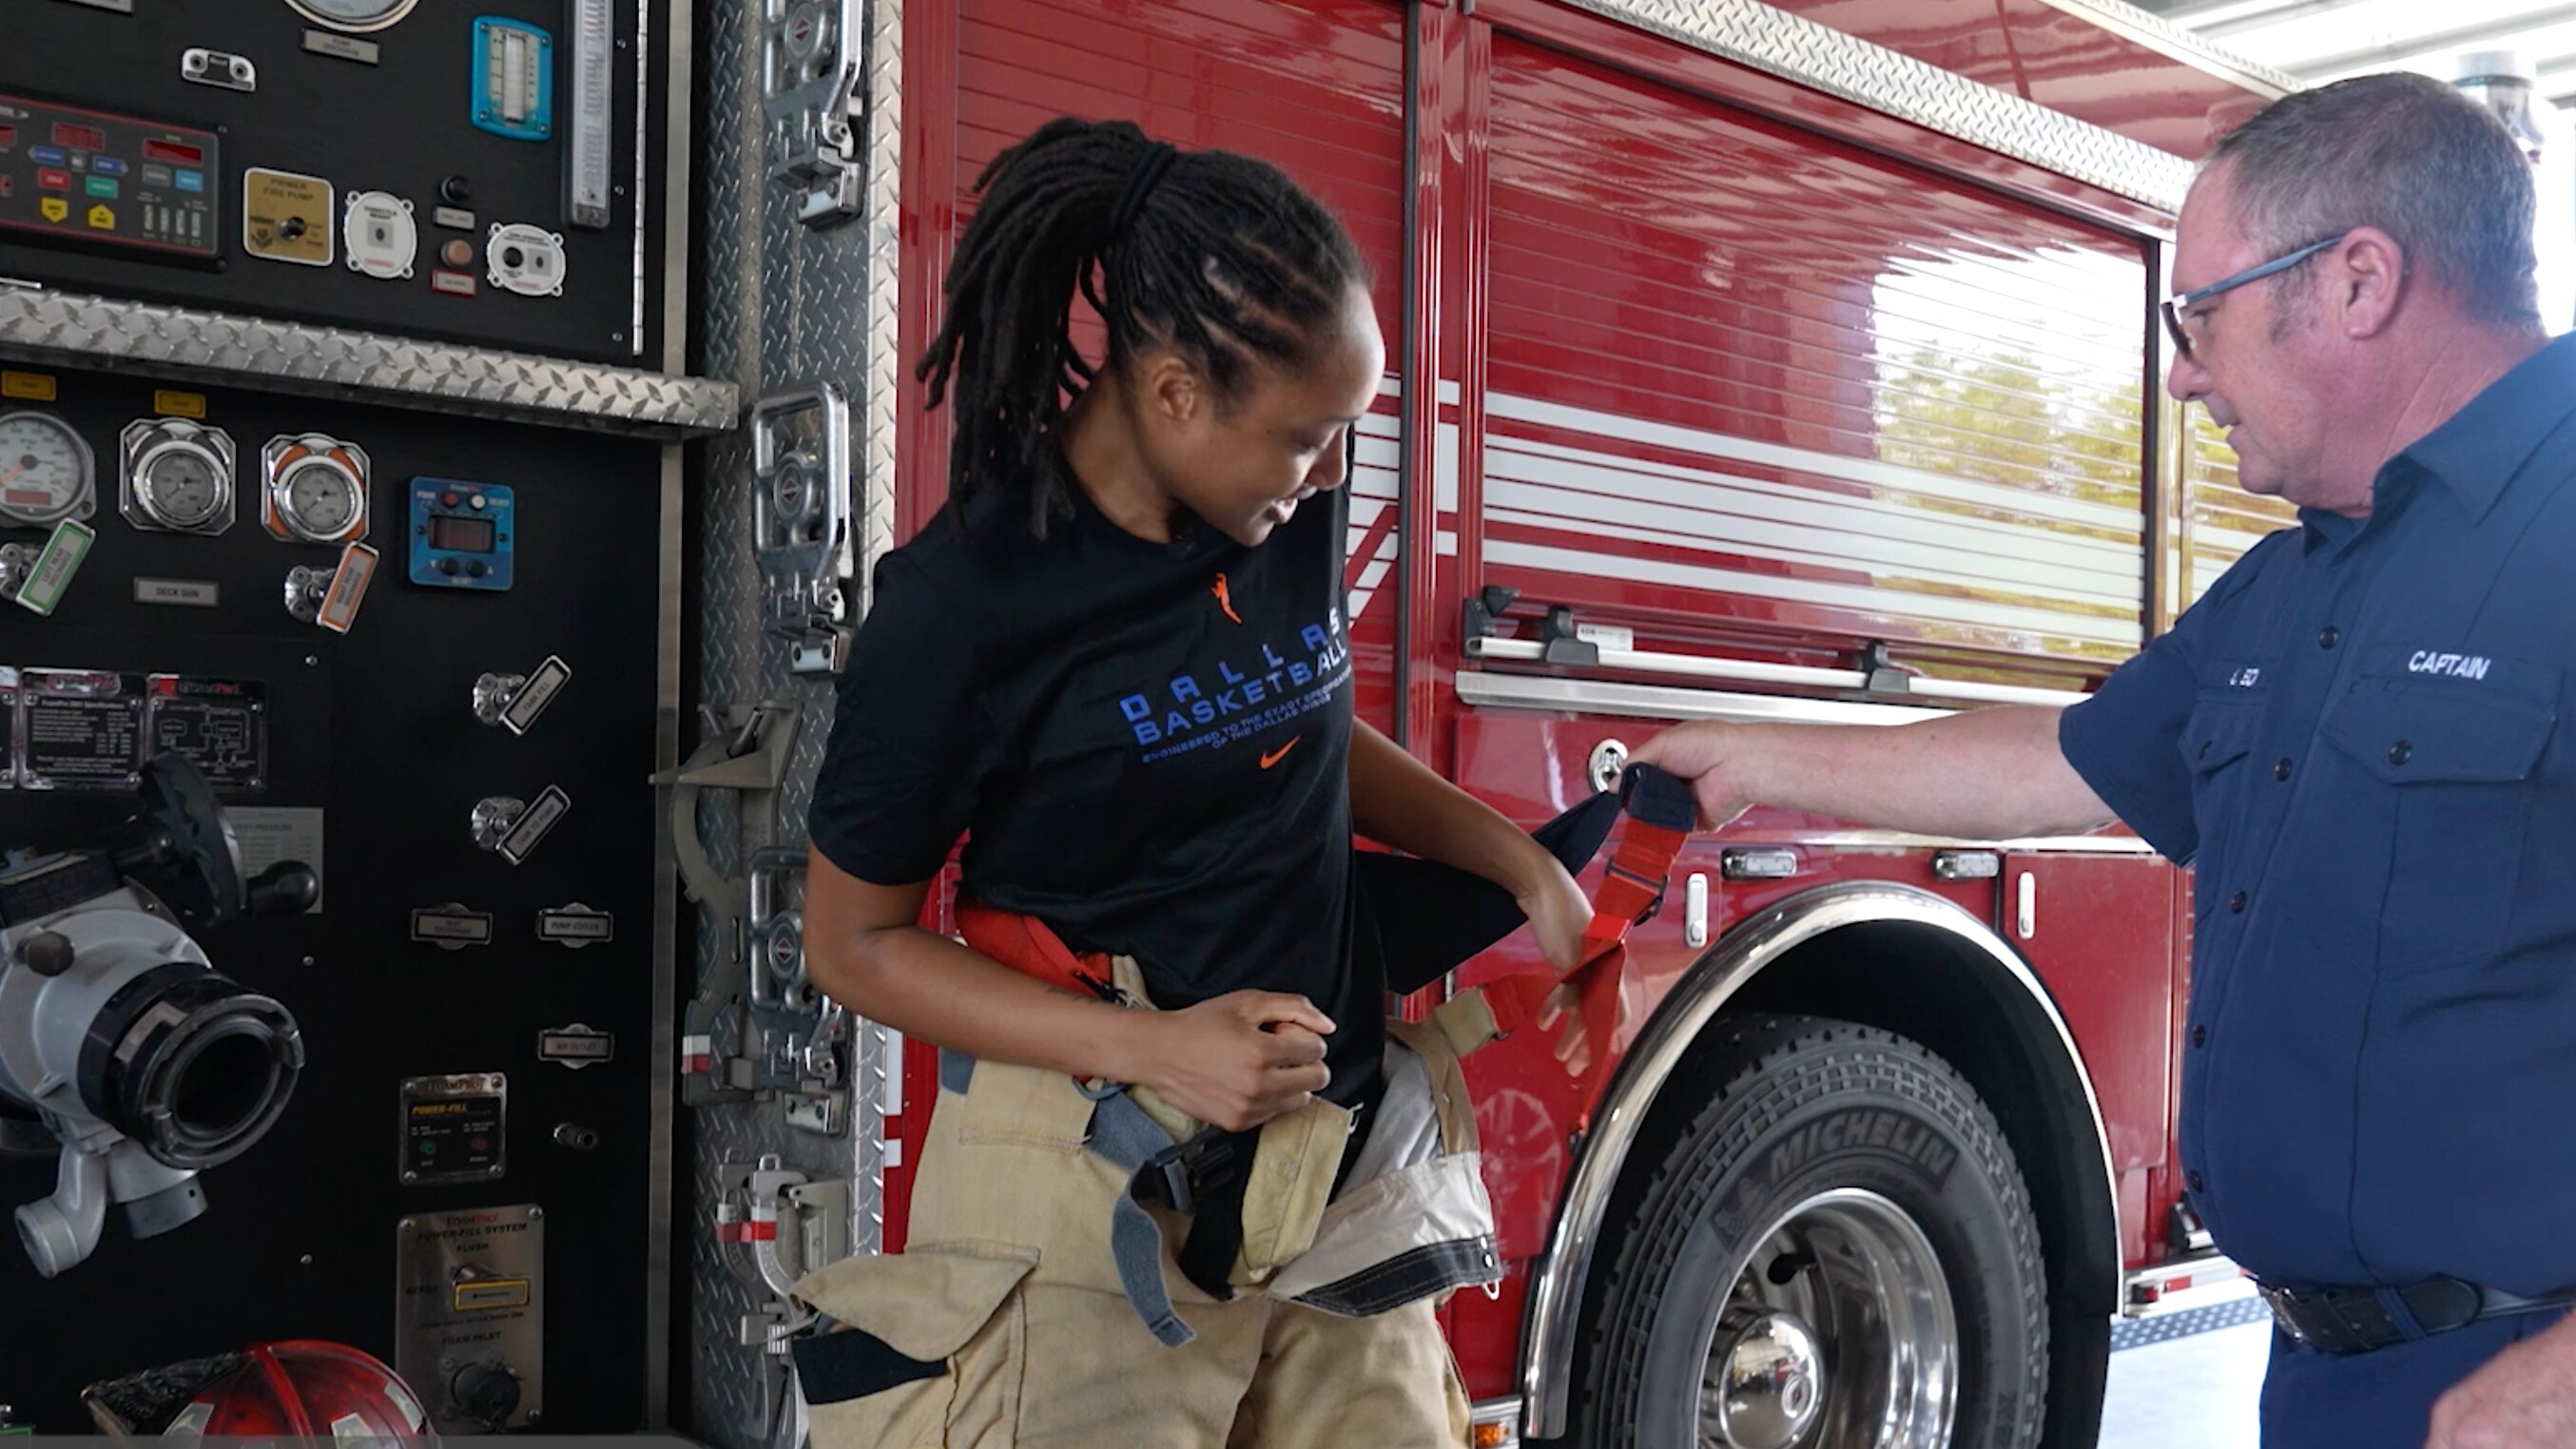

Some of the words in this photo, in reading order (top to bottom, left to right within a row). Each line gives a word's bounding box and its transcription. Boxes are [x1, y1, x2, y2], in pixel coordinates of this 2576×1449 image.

[271, 178, 307, 190] PRIMER
[264, 187, 286, 198] FIRE
[287, 190, 314, 201] PUMP
[156, 587, 179, 597] DECK
[182, 588, 200, 598] GUN
[1119, 607, 1341, 723] DALLAS
[2408, 650, 2490, 680] CAPTAIN
[1133, 638, 1347, 746] BASKETBALL
[1211, 737, 1227, 749] OF
[1229, 727, 1251, 743] THE
[1253, 710, 1299, 732] DALLAS
[1301, 693, 1332, 713] WINGS
[1142, 730, 1220, 763] ENGINEERED
[1222, 723, 1238, 735] TO
[1240, 713, 1263, 727] THE
[1265, 698, 1302, 718] EXACT
[572, 922, 599, 931] COOLER
[556, 1042, 569, 1051] AIR
[571, 1043, 596, 1052] OUTLET
[412, 1103, 467, 1115] POWER-FILL
[1770, 1110, 1956, 1183] MICHELIN
[417, 1228, 481, 1241] POWER-FILL
[484, 1223, 528, 1235] SYSTEM
[456, 1243, 490, 1253] FLUSH
[406, 1285, 438, 1295] REFILL
[442, 1335, 471, 1345] FOAM
[473, 1331, 502, 1343] INLET
